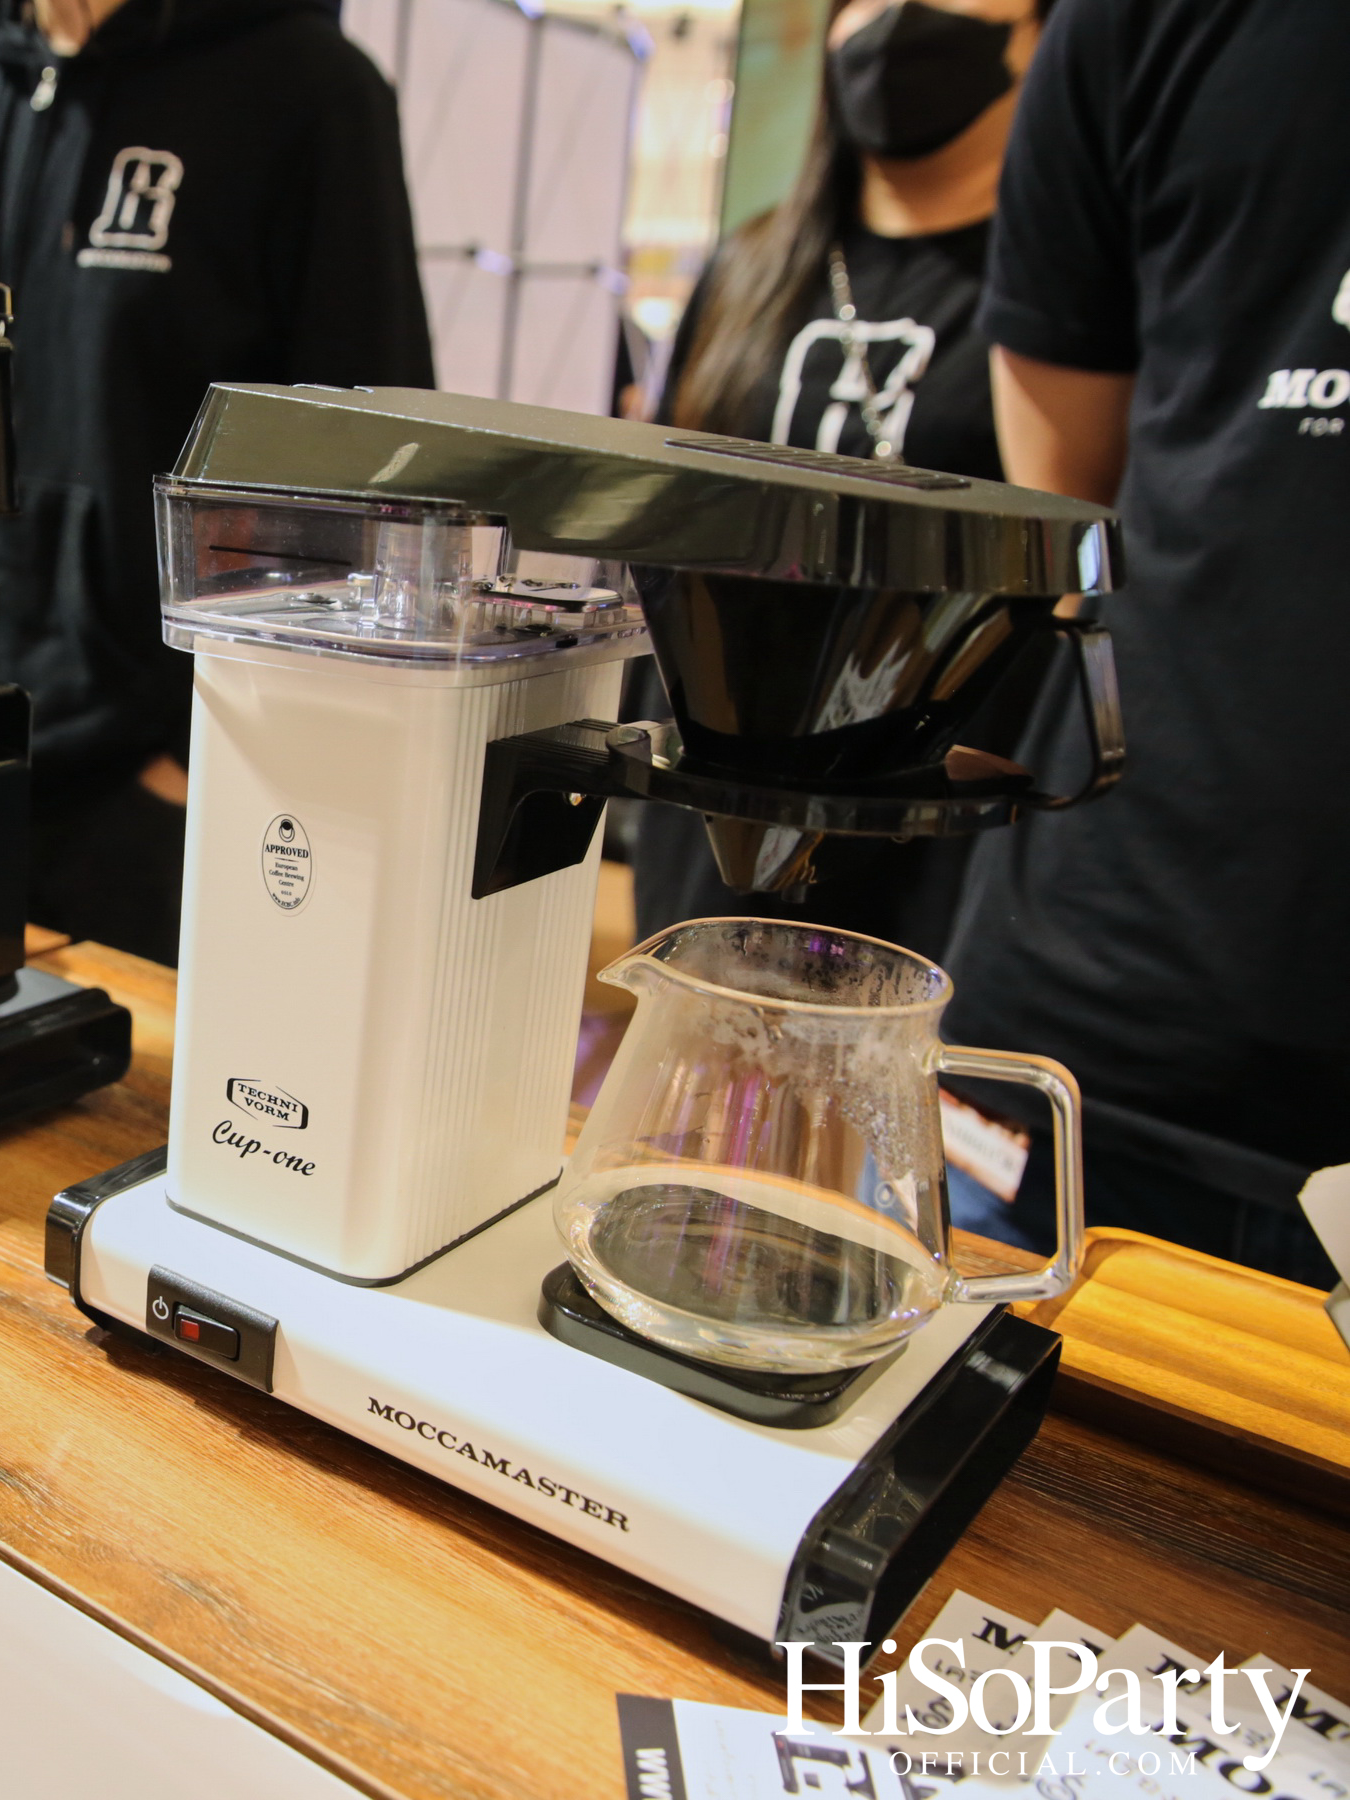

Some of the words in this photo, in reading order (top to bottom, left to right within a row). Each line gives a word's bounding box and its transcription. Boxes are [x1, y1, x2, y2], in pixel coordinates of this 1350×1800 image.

[265, 843, 309, 859] APPROVED
[269, 869, 284, 878] Coffee
[285, 872, 305, 883] Brewing
[275, 862, 298, 872] European
[278, 879, 294, 888] Centre
[237, 1083, 298, 1113] TECHNI
[243, 1096, 290, 1122] VORM
[212, 1119, 316, 1176] Cup-one
[367, 1396, 631, 1533] MOCCAMASTER
